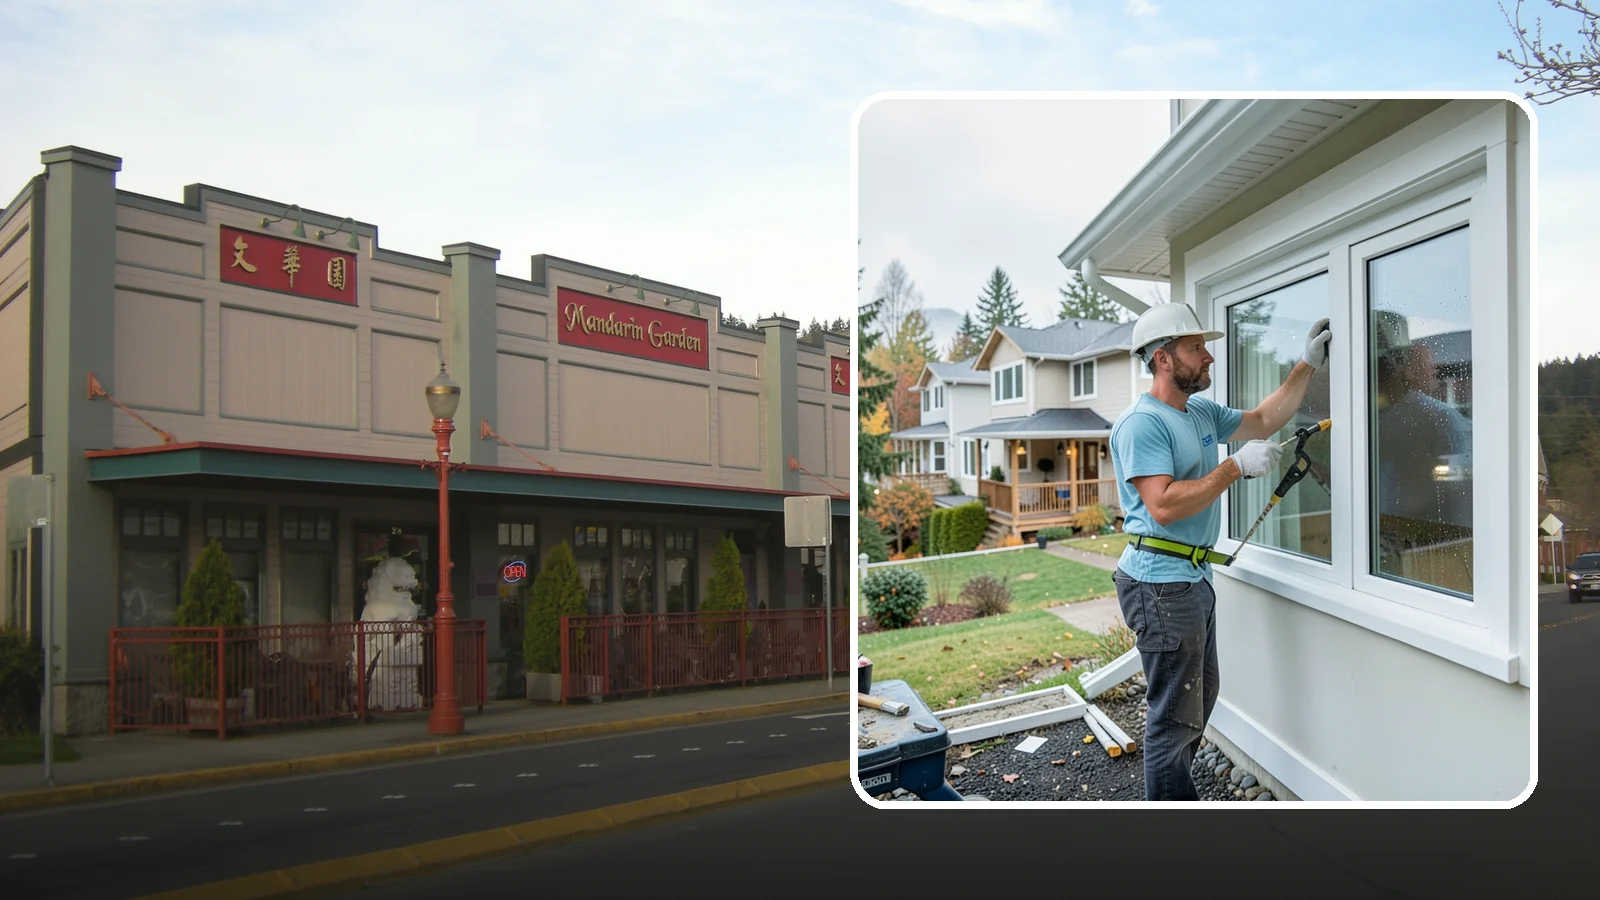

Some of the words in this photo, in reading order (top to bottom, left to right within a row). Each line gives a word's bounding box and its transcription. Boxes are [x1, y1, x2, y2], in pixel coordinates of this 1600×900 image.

[565, 303, 643, 340] Mandarin
[648, 321, 702, 352] Garden
[503, 565, 527, 578] OPEN
